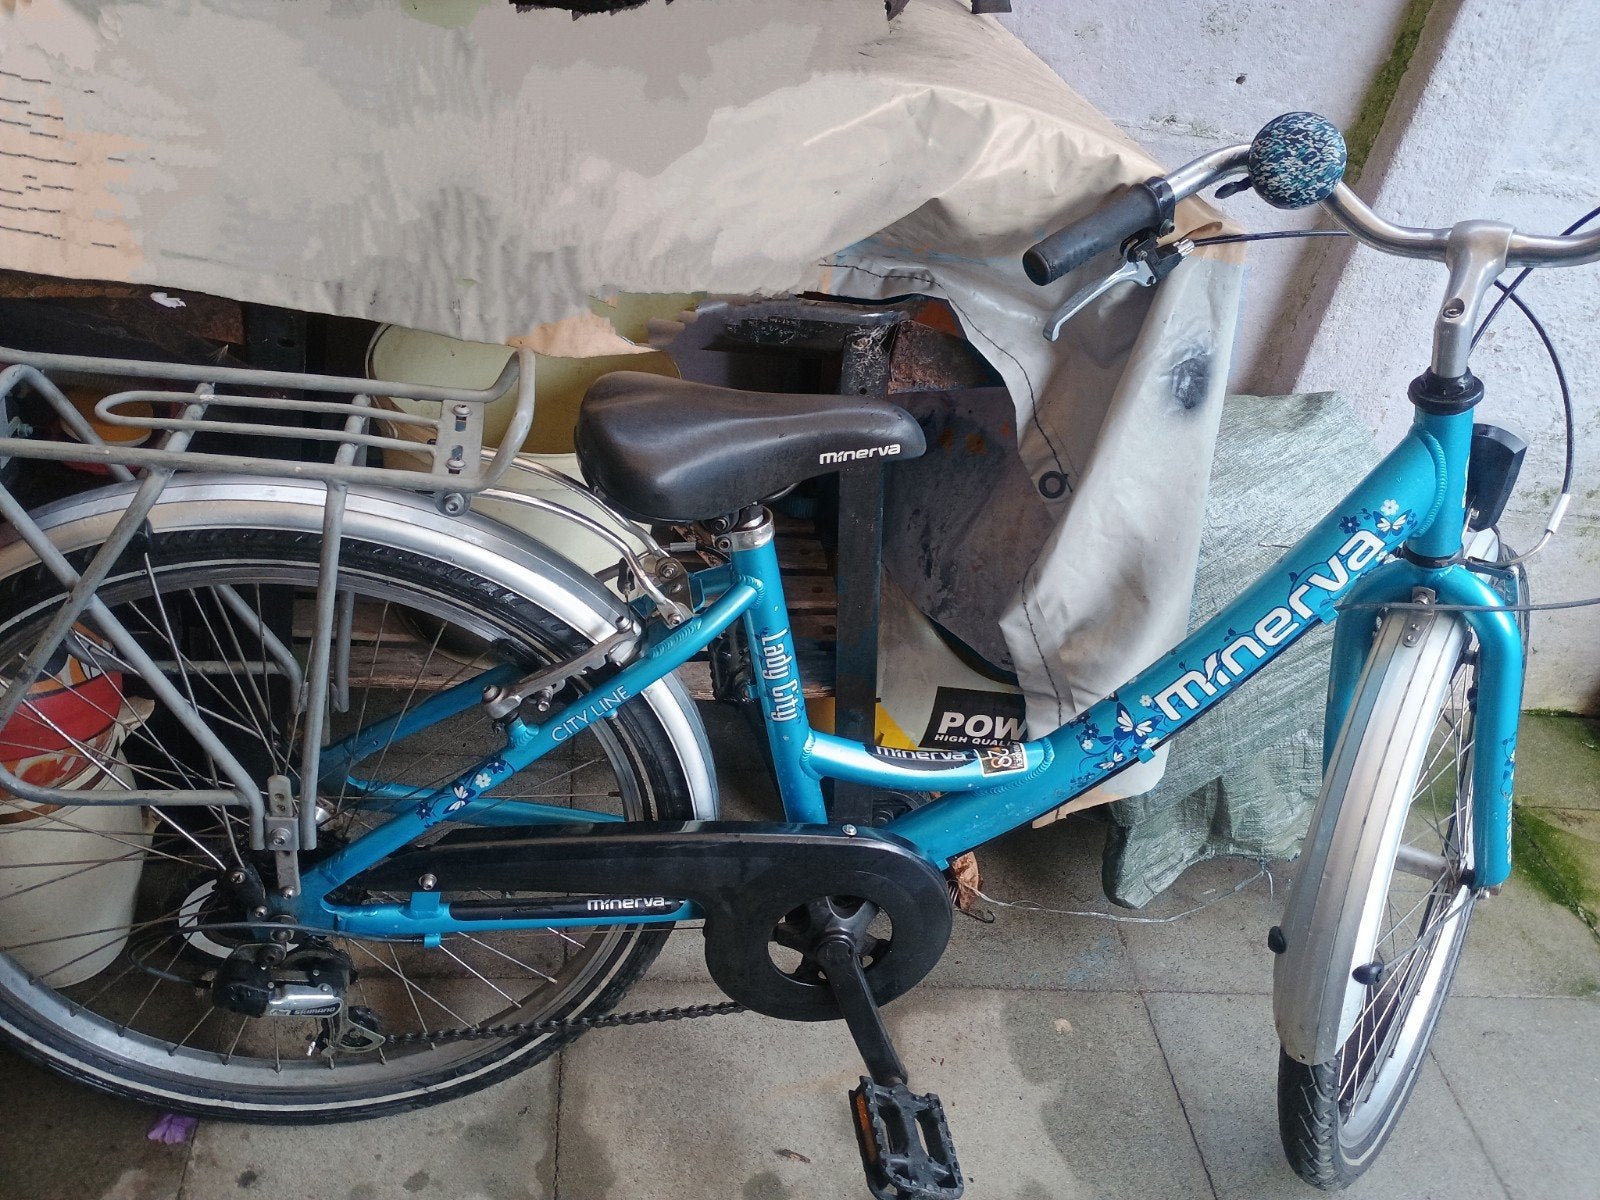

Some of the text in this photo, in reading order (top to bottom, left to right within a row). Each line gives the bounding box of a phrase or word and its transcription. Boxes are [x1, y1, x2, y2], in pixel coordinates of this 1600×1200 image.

[819, 443, 901, 465] minerva
[1153, 529, 1386, 721] minerva
[761, 628, 798, 721] Lady City
[551, 685, 631, 741] CITY LINE
[934, 734, 968, 743] HIGH
[875, 745, 966, 761] minerva
[587, 896, 665, 911] minerva
